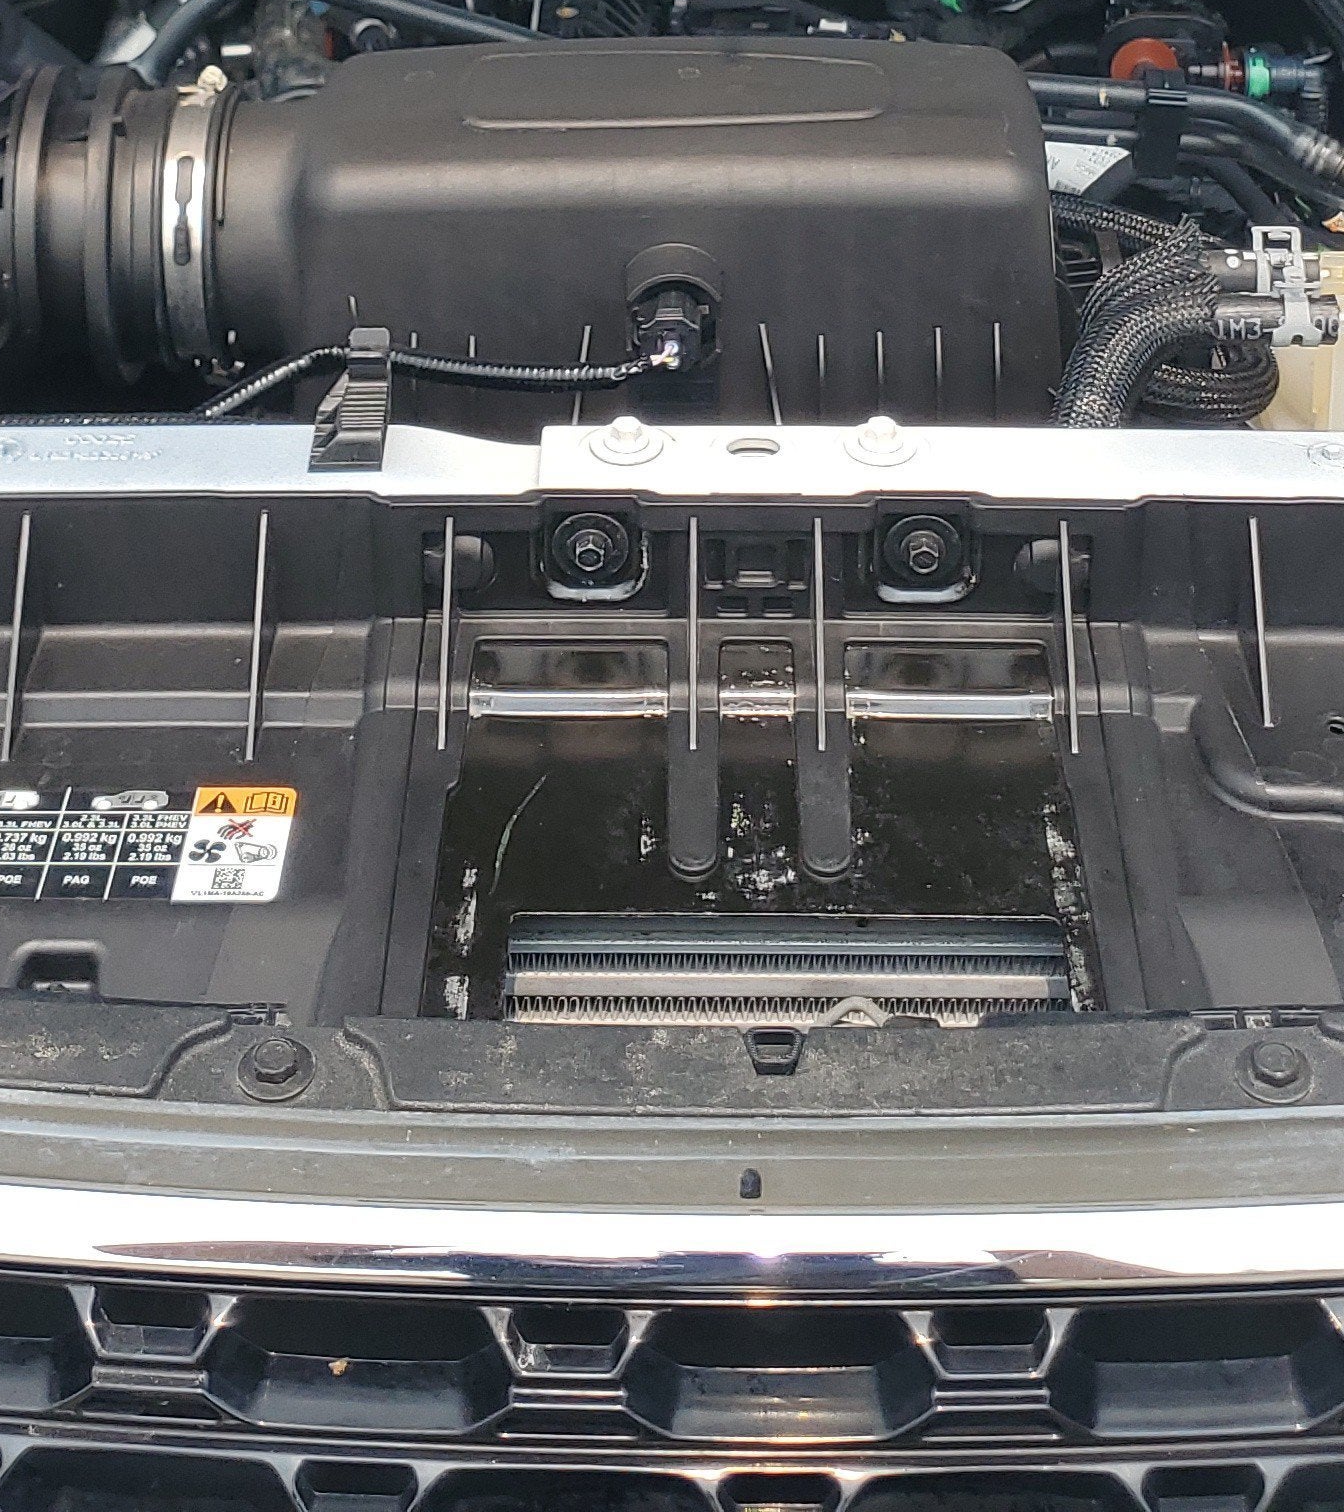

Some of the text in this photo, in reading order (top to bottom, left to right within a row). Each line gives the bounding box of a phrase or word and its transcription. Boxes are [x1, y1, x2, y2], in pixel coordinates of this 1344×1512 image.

[29, 833, 48, 845] kg
[62, 833, 117, 845] 0.992 kg
[127, 833, 183, 845] 0.992 kg
[62, 875, 90, 884] PAG
[131, 875, 158, 885] POE
